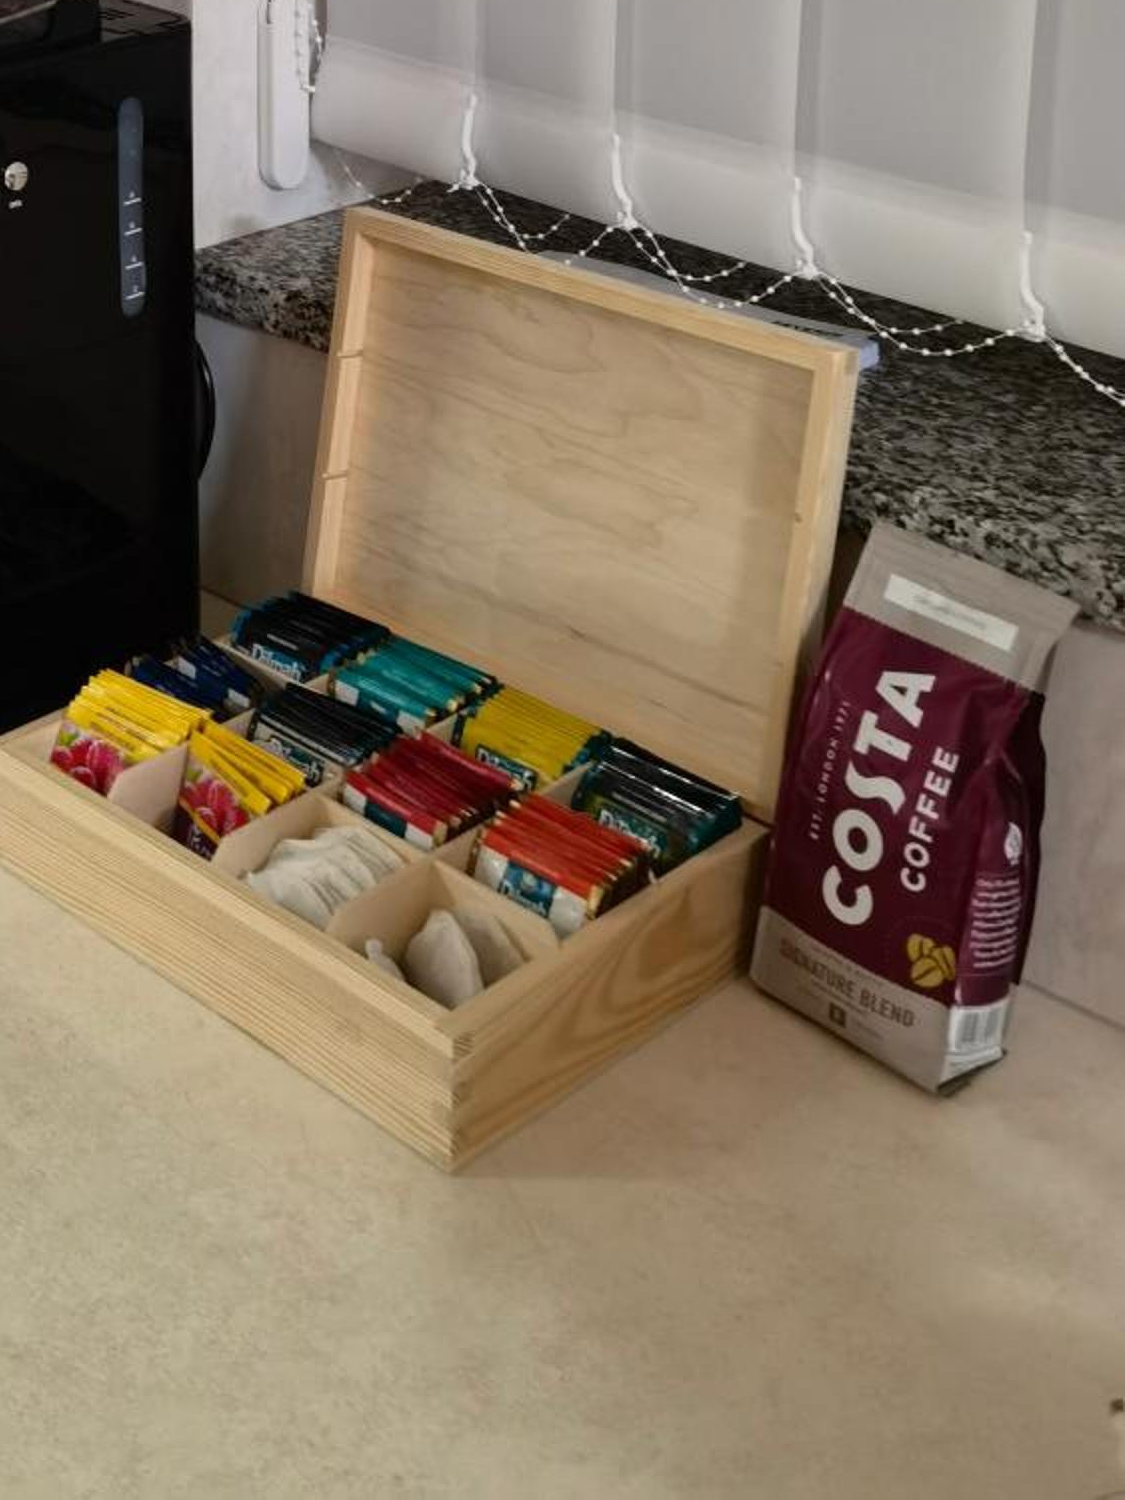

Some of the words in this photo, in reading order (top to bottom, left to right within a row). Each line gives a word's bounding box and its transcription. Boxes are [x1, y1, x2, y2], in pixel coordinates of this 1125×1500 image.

[822, 670, 936, 926] COSTA
[900, 747, 959, 892] COFFEE
[860, 988, 916, 1028] BLEND
